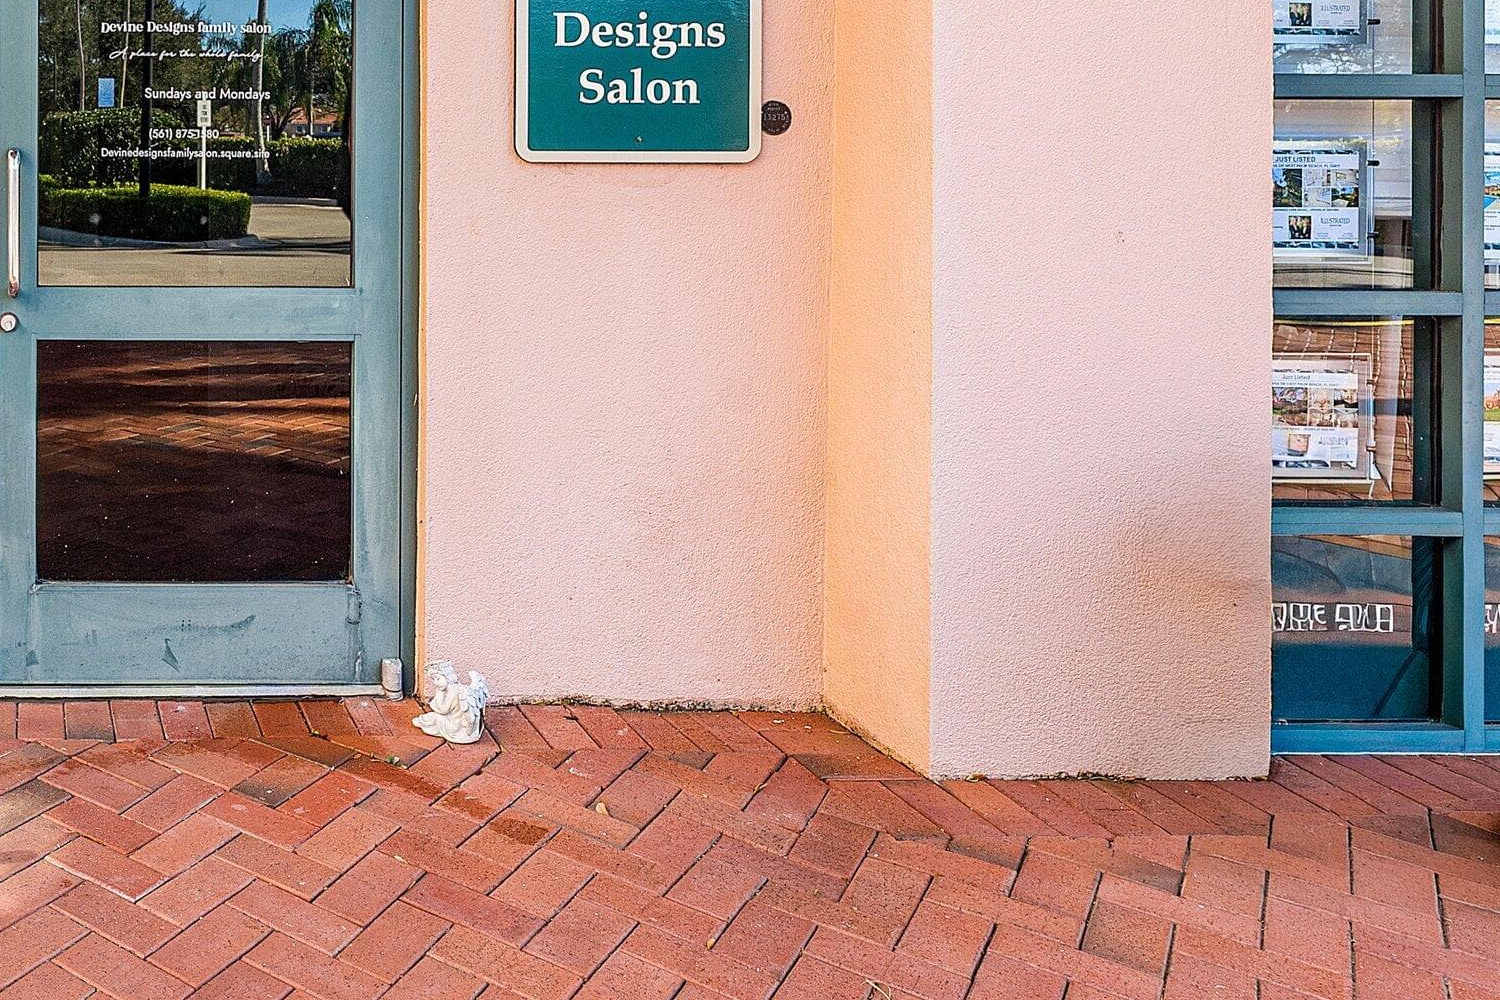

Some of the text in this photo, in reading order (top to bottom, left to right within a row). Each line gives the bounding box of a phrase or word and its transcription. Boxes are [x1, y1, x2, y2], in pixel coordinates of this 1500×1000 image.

[101, 21, 272, 36] Devine Designs family salon
[552, 11, 726, 59] Designs
[108, 46, 264, 62] A place for the whole family
[144, 87, 271, 100] Sundays and Mondays
[578, 67, 700, 104] Salon
[149, 128, 173, 141] (561)
[101, 146, 271, 162] Devinedesignsfamilysaon.square.site
